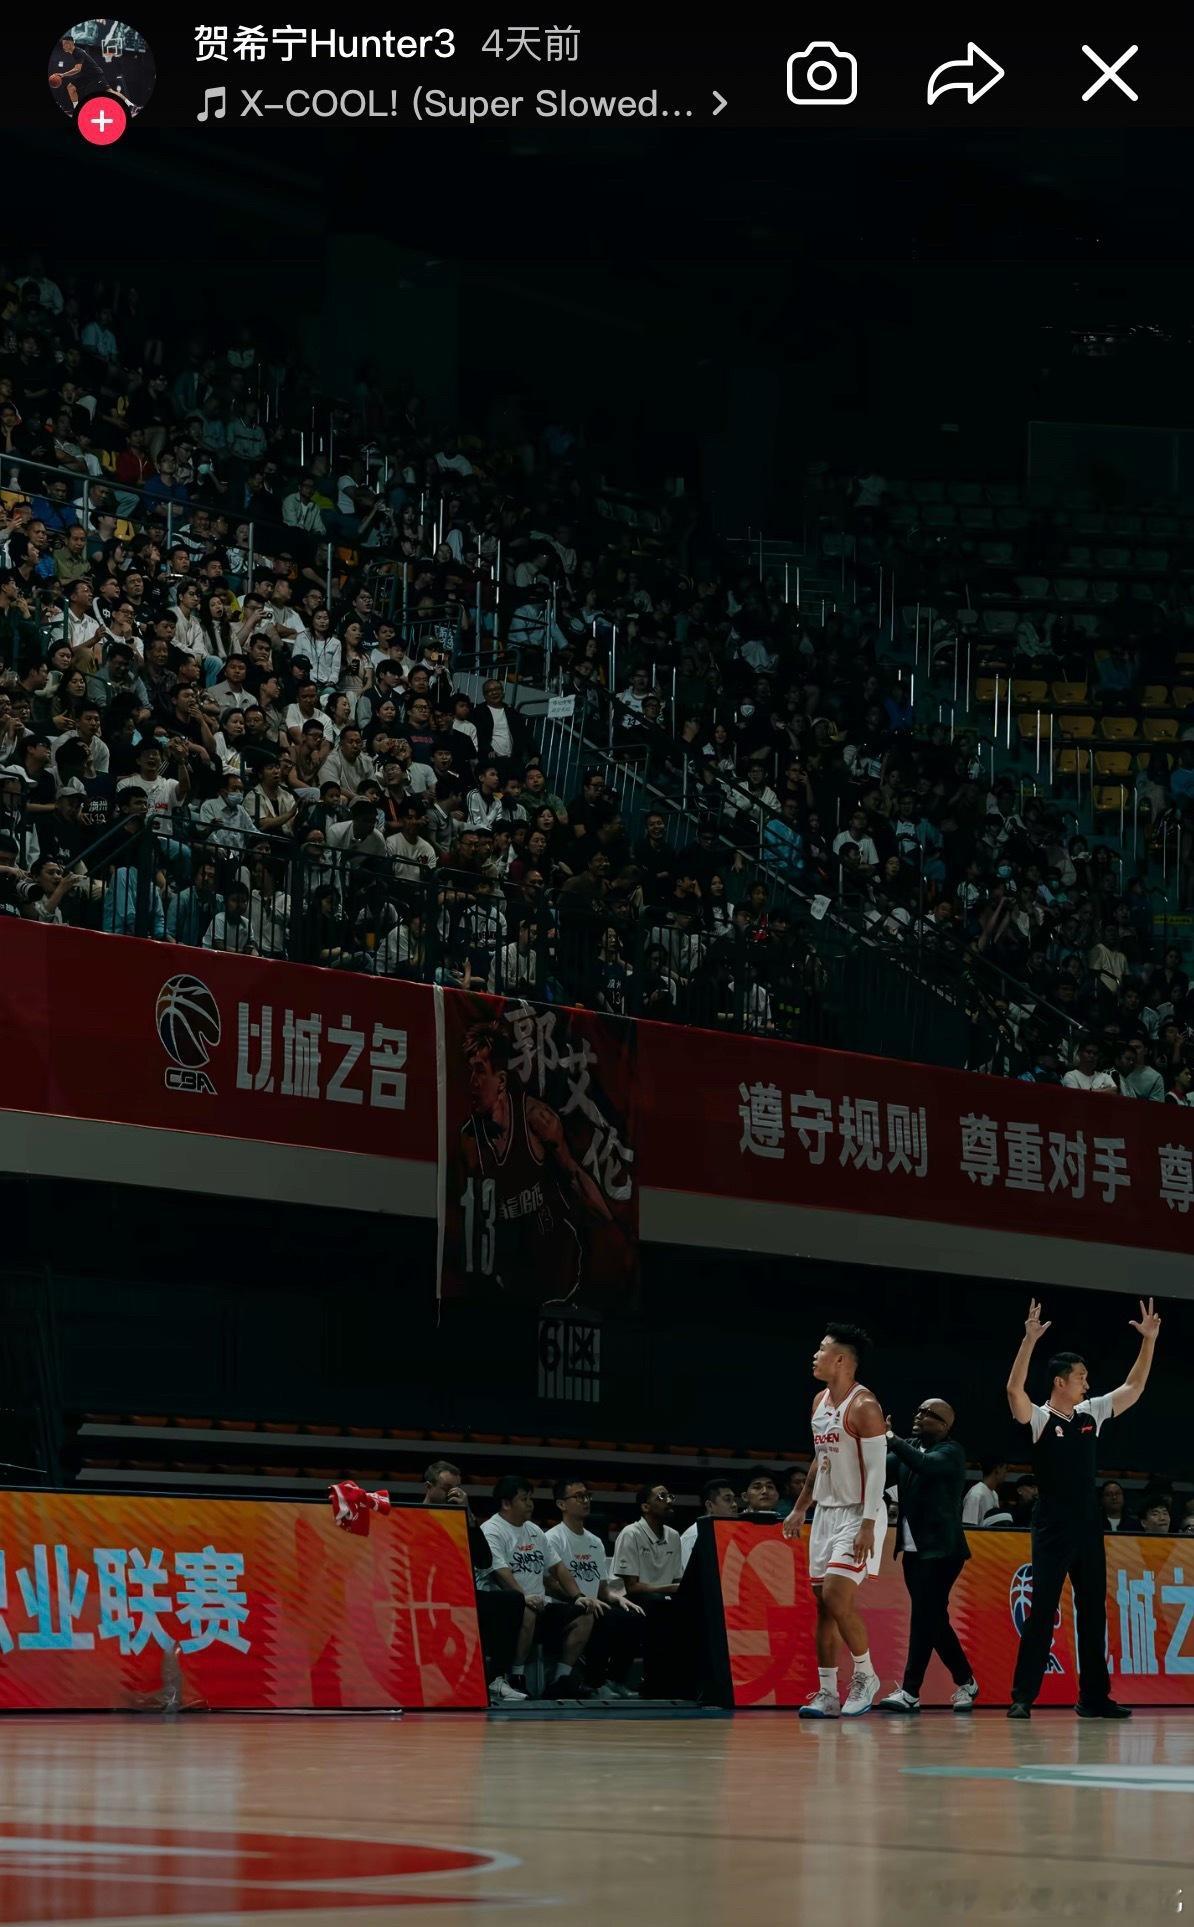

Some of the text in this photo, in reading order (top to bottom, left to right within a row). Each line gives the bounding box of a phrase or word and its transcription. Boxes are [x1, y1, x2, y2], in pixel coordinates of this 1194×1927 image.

[165, 1067, 218, 1095] CBA
[236, 1001, 408, 1111] 以城之名
[738, 1081, 1194, 1214] 遵守规则 尊重对手 尊
[460, 1176, 496, 1276] 13
[0, 1544, 252, 1655] 业联赛
[1071, 1567, 1194, 1675] 城之
